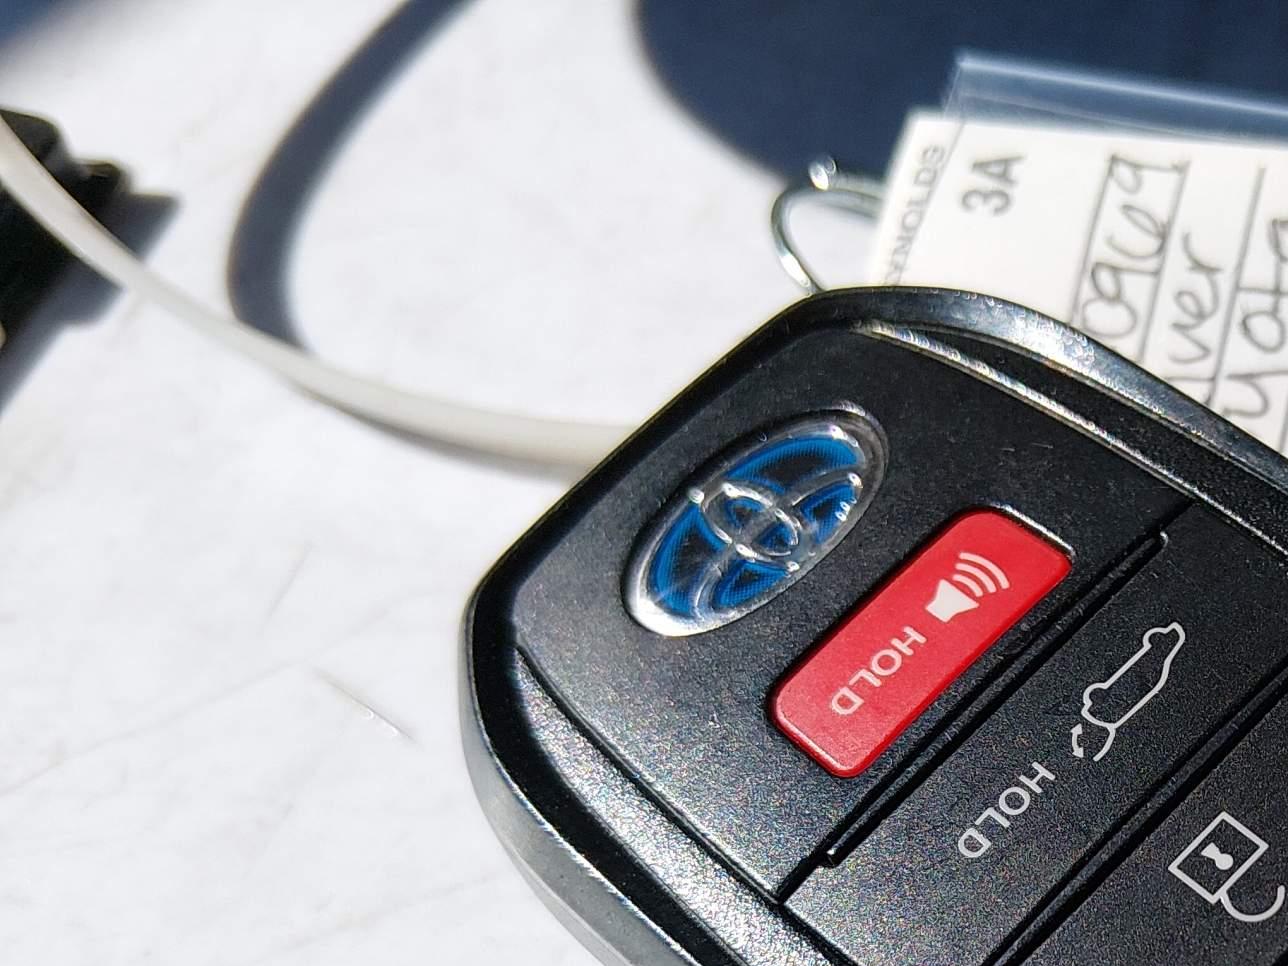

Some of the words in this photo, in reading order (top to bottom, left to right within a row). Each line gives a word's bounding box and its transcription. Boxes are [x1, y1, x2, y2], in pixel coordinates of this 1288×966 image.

[960, 154, 1025, 217] 3A
[830, 626, 928, 716] HOLD
[957, 760, 1056, 858] HOLD
